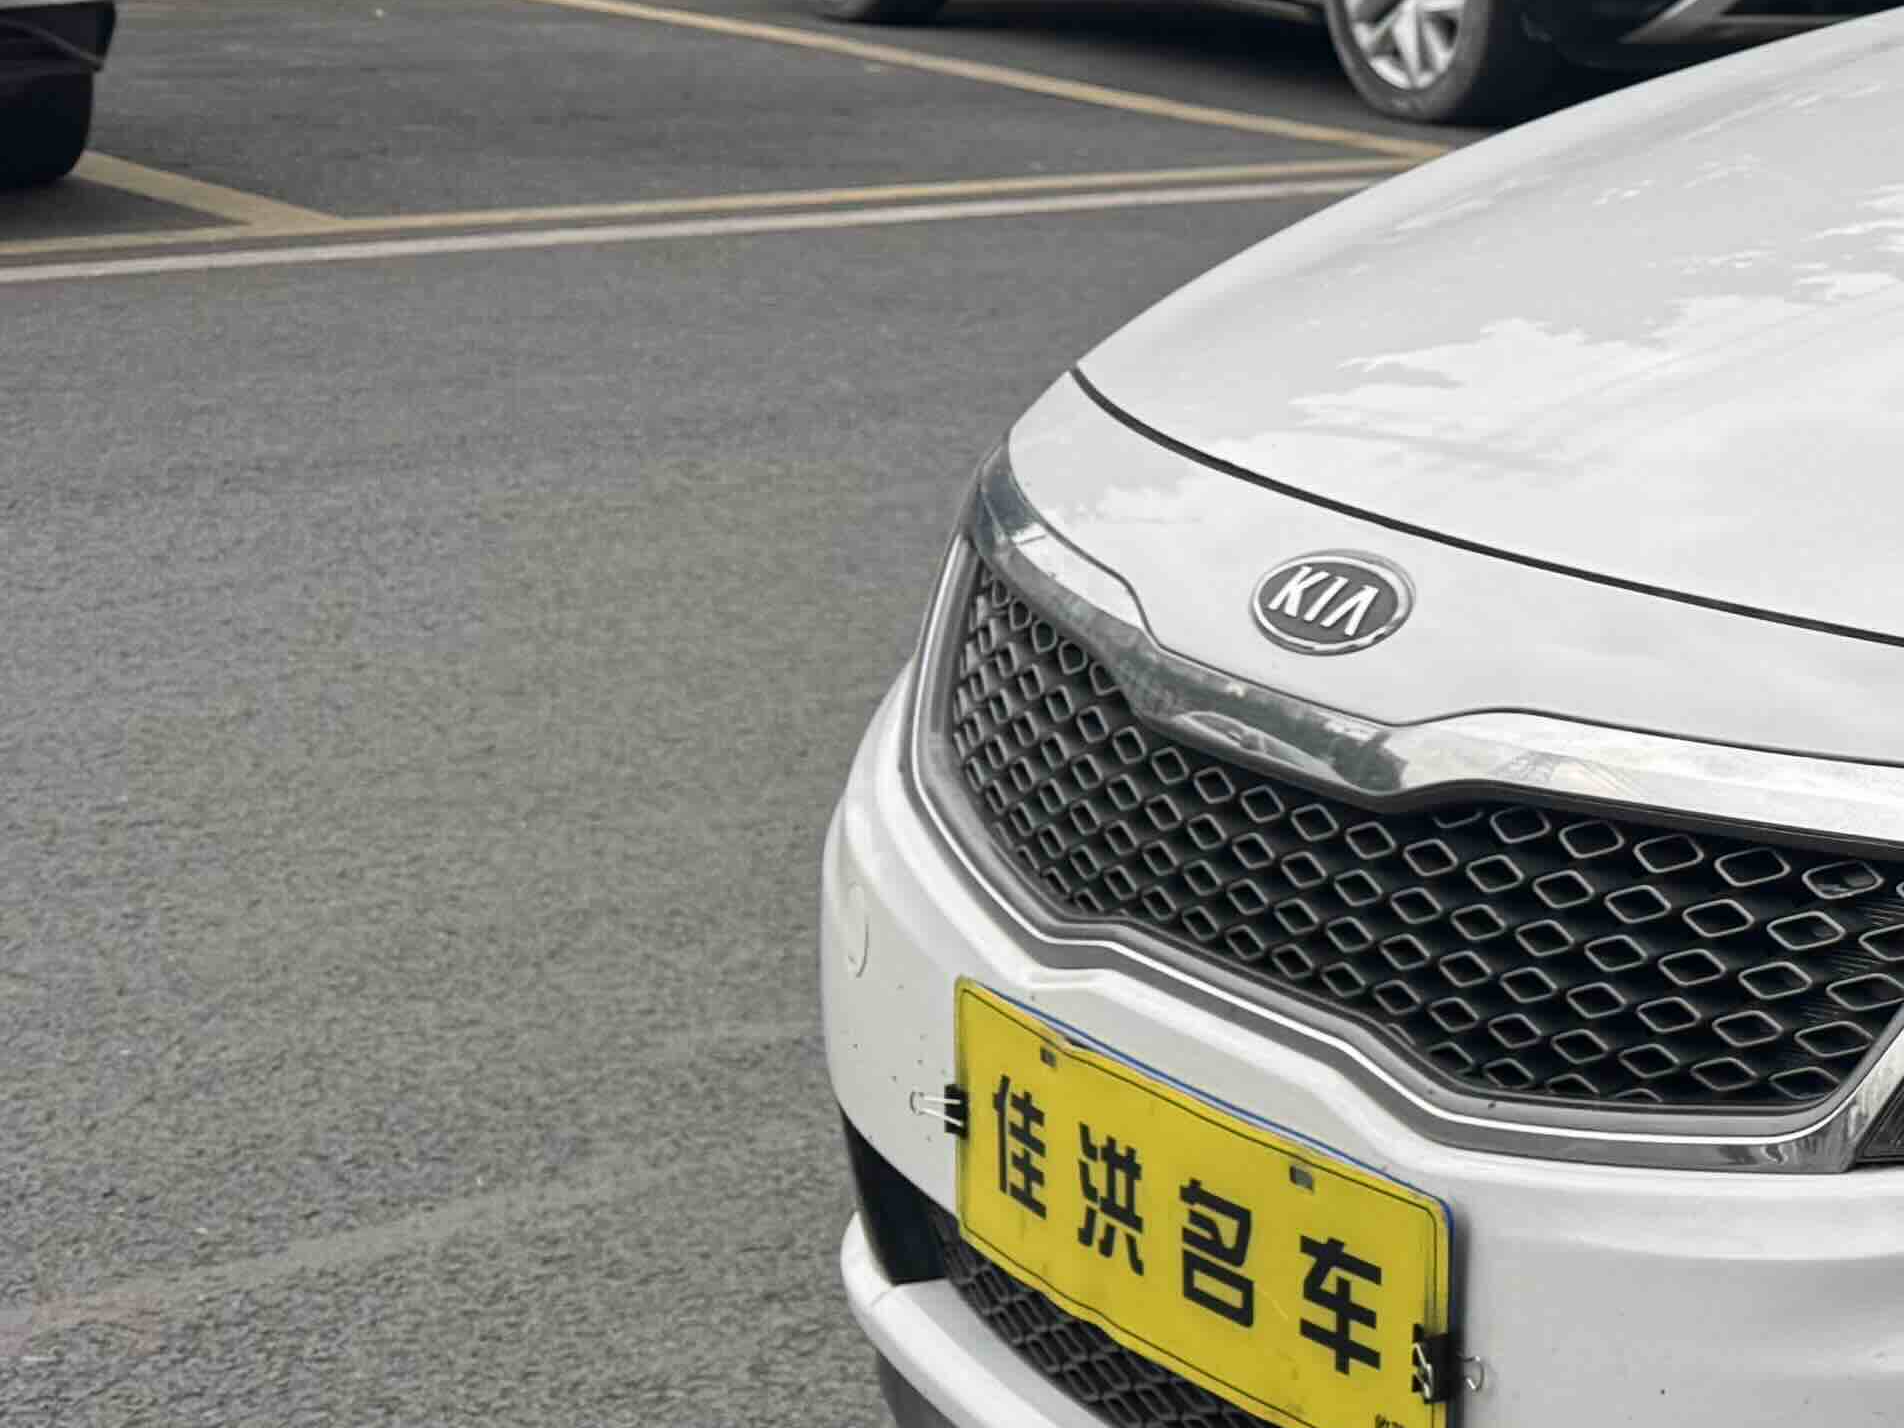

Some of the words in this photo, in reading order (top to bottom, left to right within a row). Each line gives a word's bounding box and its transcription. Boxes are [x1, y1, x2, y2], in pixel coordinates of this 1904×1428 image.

[1267, 565, 1380, 638] KIA
[991, 1073, 1383, 1375] 佳洪名车
